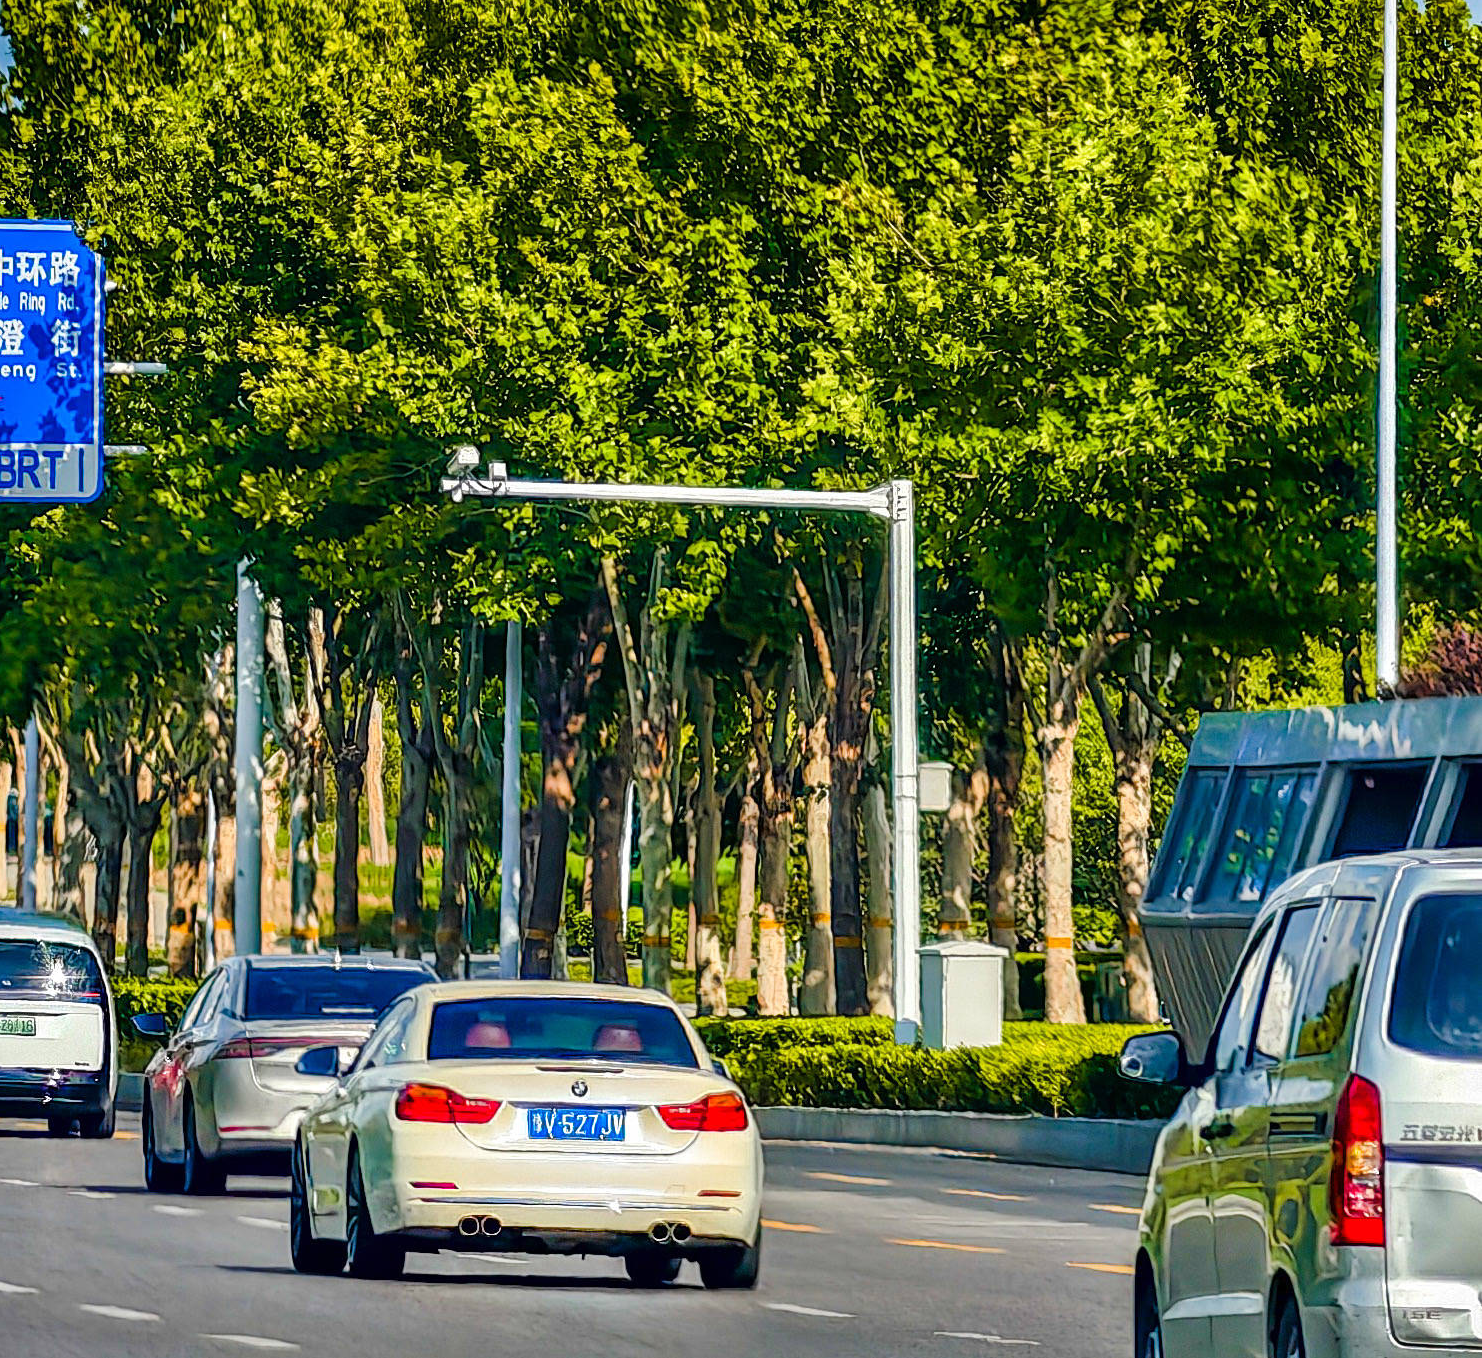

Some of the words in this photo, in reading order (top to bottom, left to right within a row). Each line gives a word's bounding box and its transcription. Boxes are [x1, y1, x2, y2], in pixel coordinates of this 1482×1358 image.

[19, 292, 46, 316] Ring
[57, 292, 80, 311] Rd.
[56, 362, 82, 378] St.
